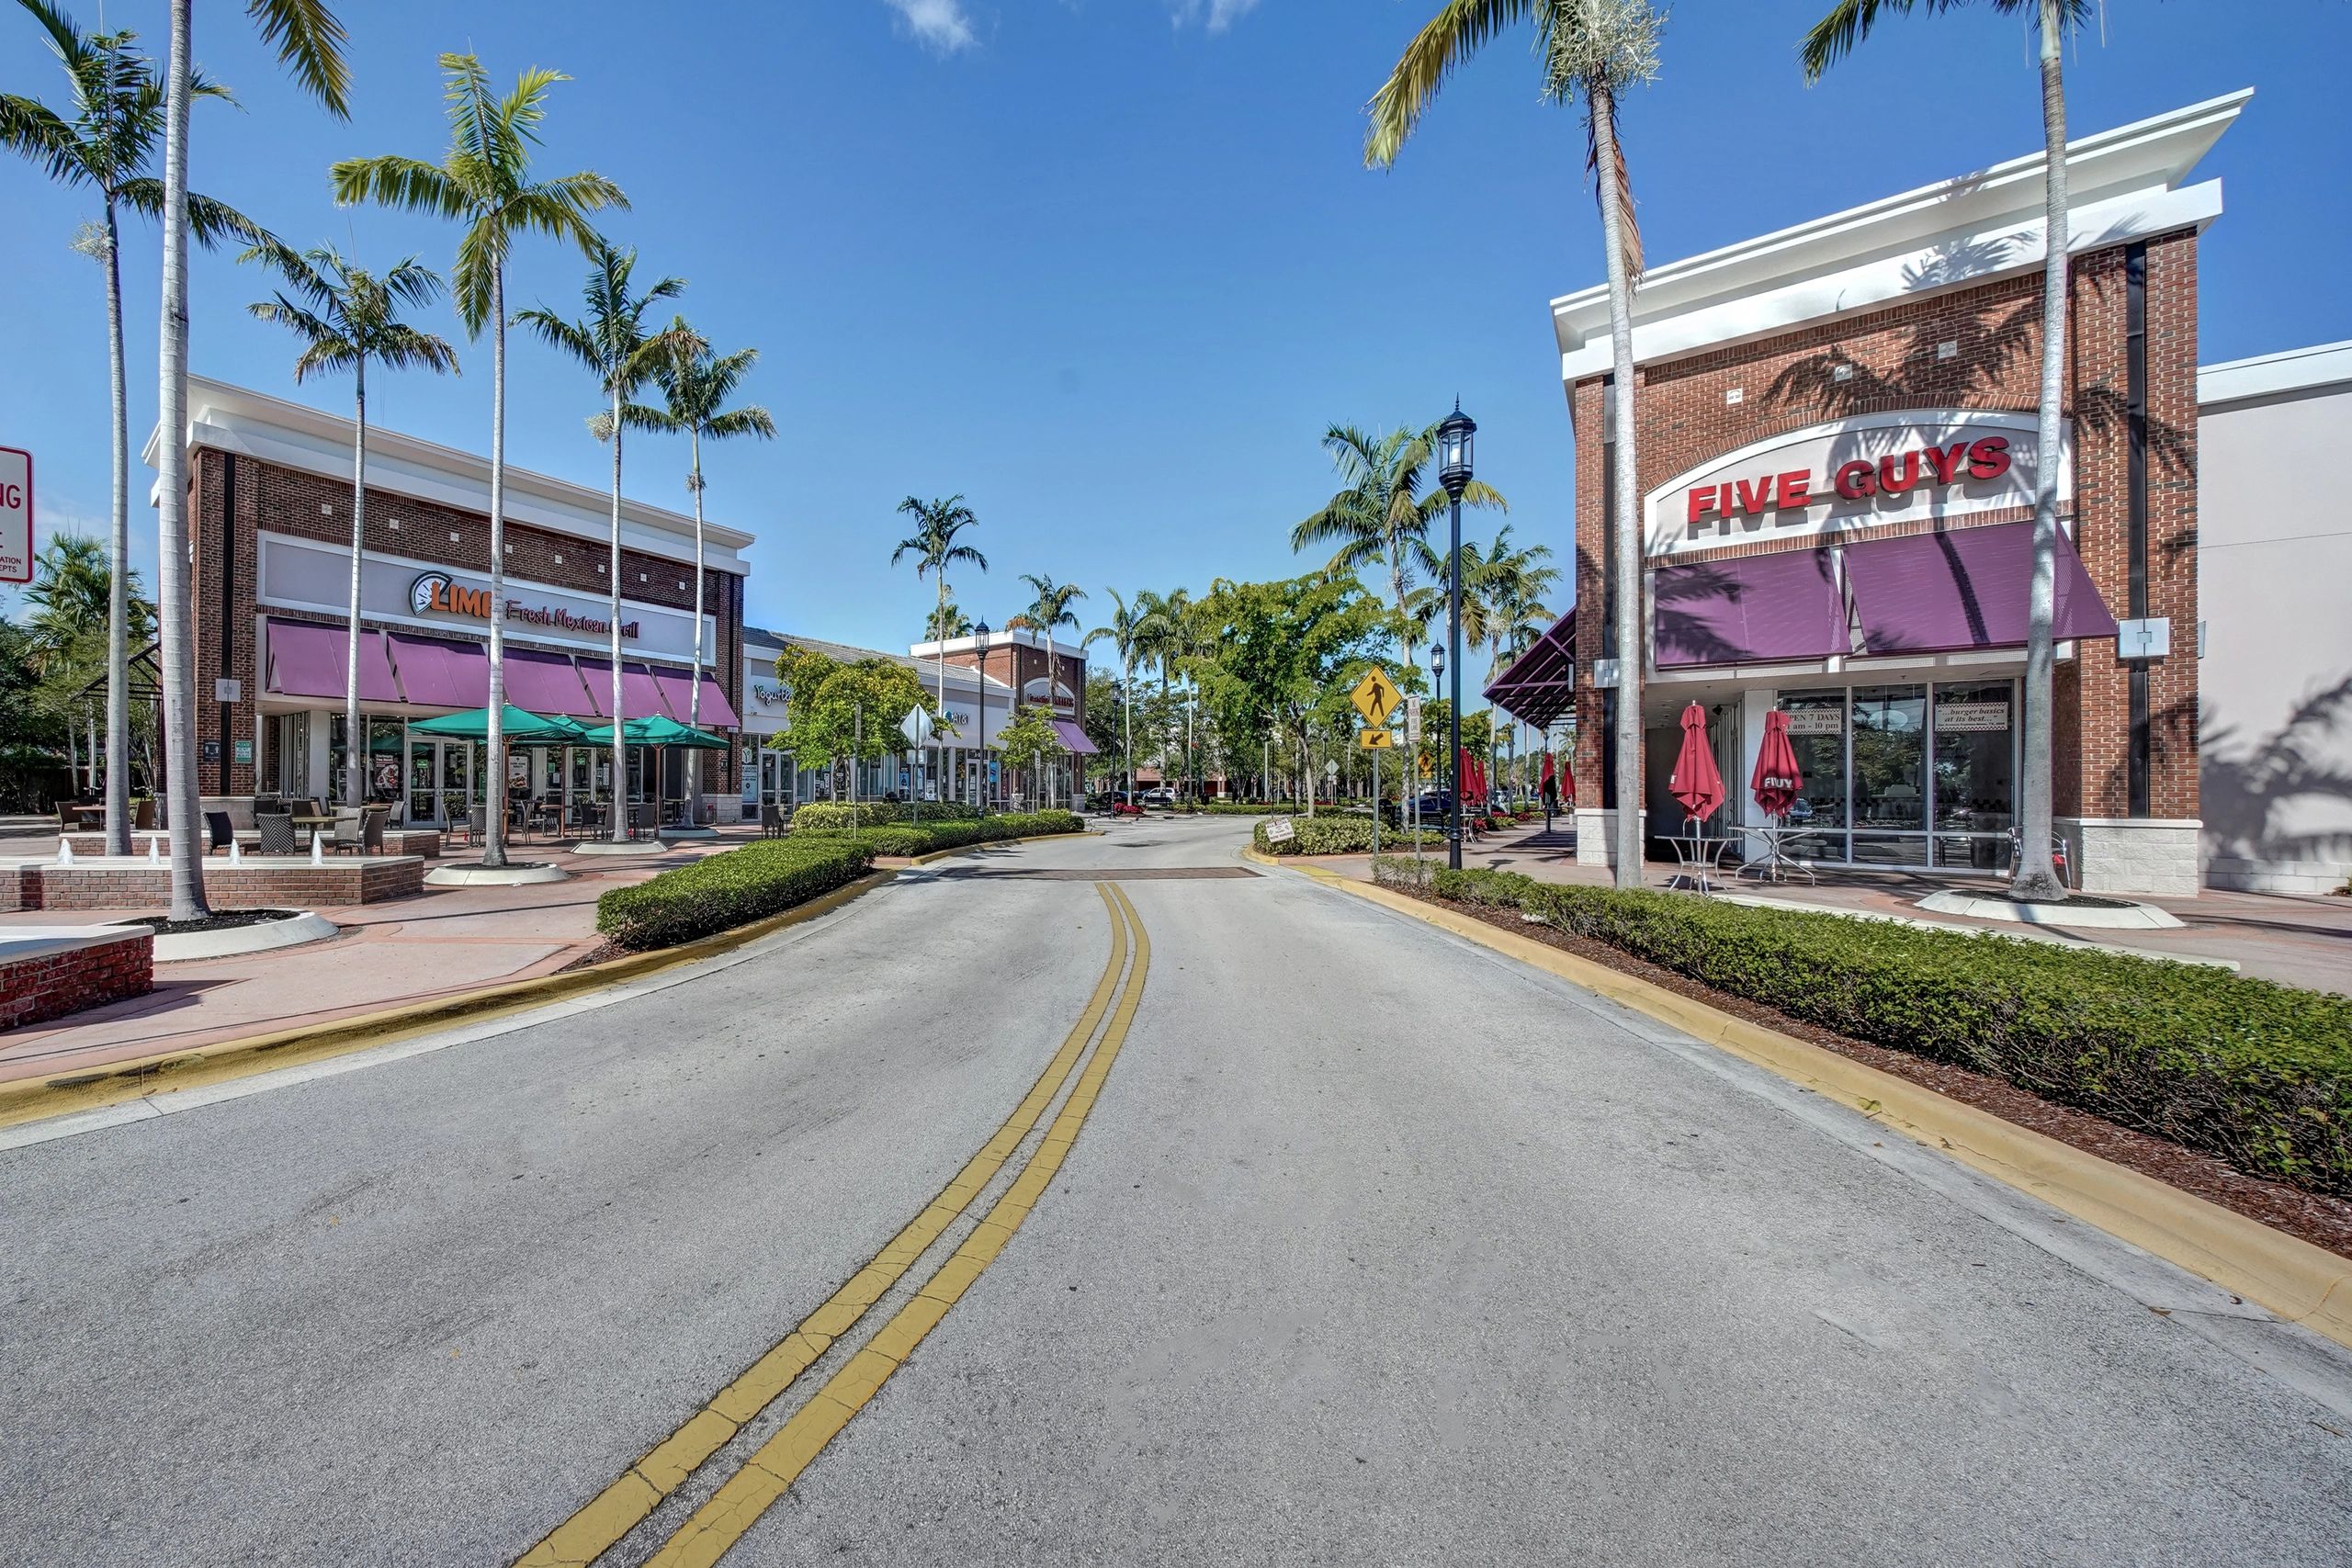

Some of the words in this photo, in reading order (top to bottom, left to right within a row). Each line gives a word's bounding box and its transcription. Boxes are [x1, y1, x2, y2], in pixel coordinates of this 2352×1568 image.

[1689, 468, 1813, 524] FIVE
[1834, 436, 2012, 500] GUYS
[0, 556, 22, 565] ATION
[505, 600, 550, 626] Fresh
[554, 608, 607, 634] Mexican
[754, 684, 792, 706] Yogurtl
[1789, 714, 1806, 722] PEN
[1809, 713, 1815, 721] 7
[1817, 713, 1840, 721] DAYS
[1815, 721, 1823, 729] 10
[1825, 723, 1838, 731] pm
